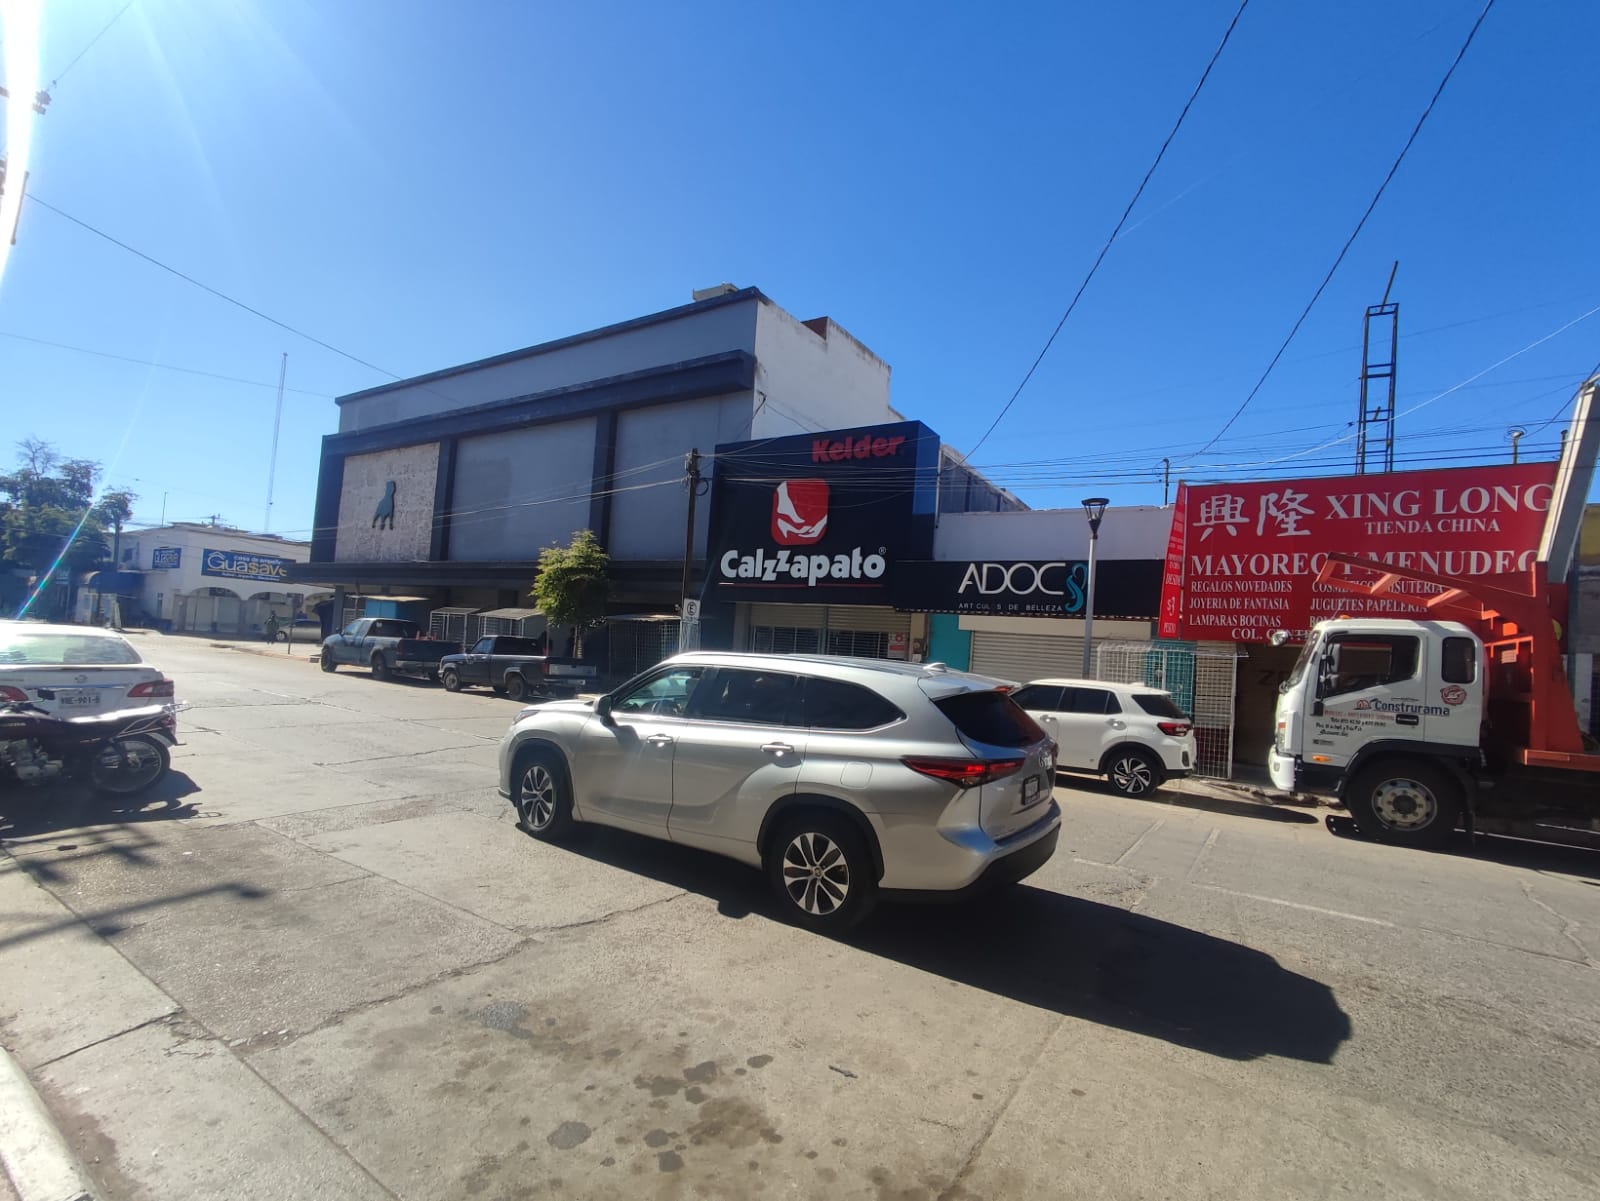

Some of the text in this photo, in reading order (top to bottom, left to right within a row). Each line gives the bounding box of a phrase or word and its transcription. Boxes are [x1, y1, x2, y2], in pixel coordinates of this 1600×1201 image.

[811, 435, 906, 463] Kelder
[1324, 483, 1554, 520] XING LONG
[1192, 488, 1316, 542] 興隆
[1364, 517, 1501, 535] TIENDA CHINA
[1191, 581, 1233, 593] REGALOS
[1235, 580, 1293, 593] NOVEDADES
[1008, 603, 1019, 611] DE
[1025, 604, 1063, 612] BELLEZA
[1189, 597, 1290, 610] JOYERIA DE FANTASIA
[1310, 598, 1364, 611] JUGUETES
[1189, 614, 1281, 627] LAMPARAS BOCINAS
[1231, 628, 1263, 640] COL.
[1374, 700, 1450, 716] Construrama
